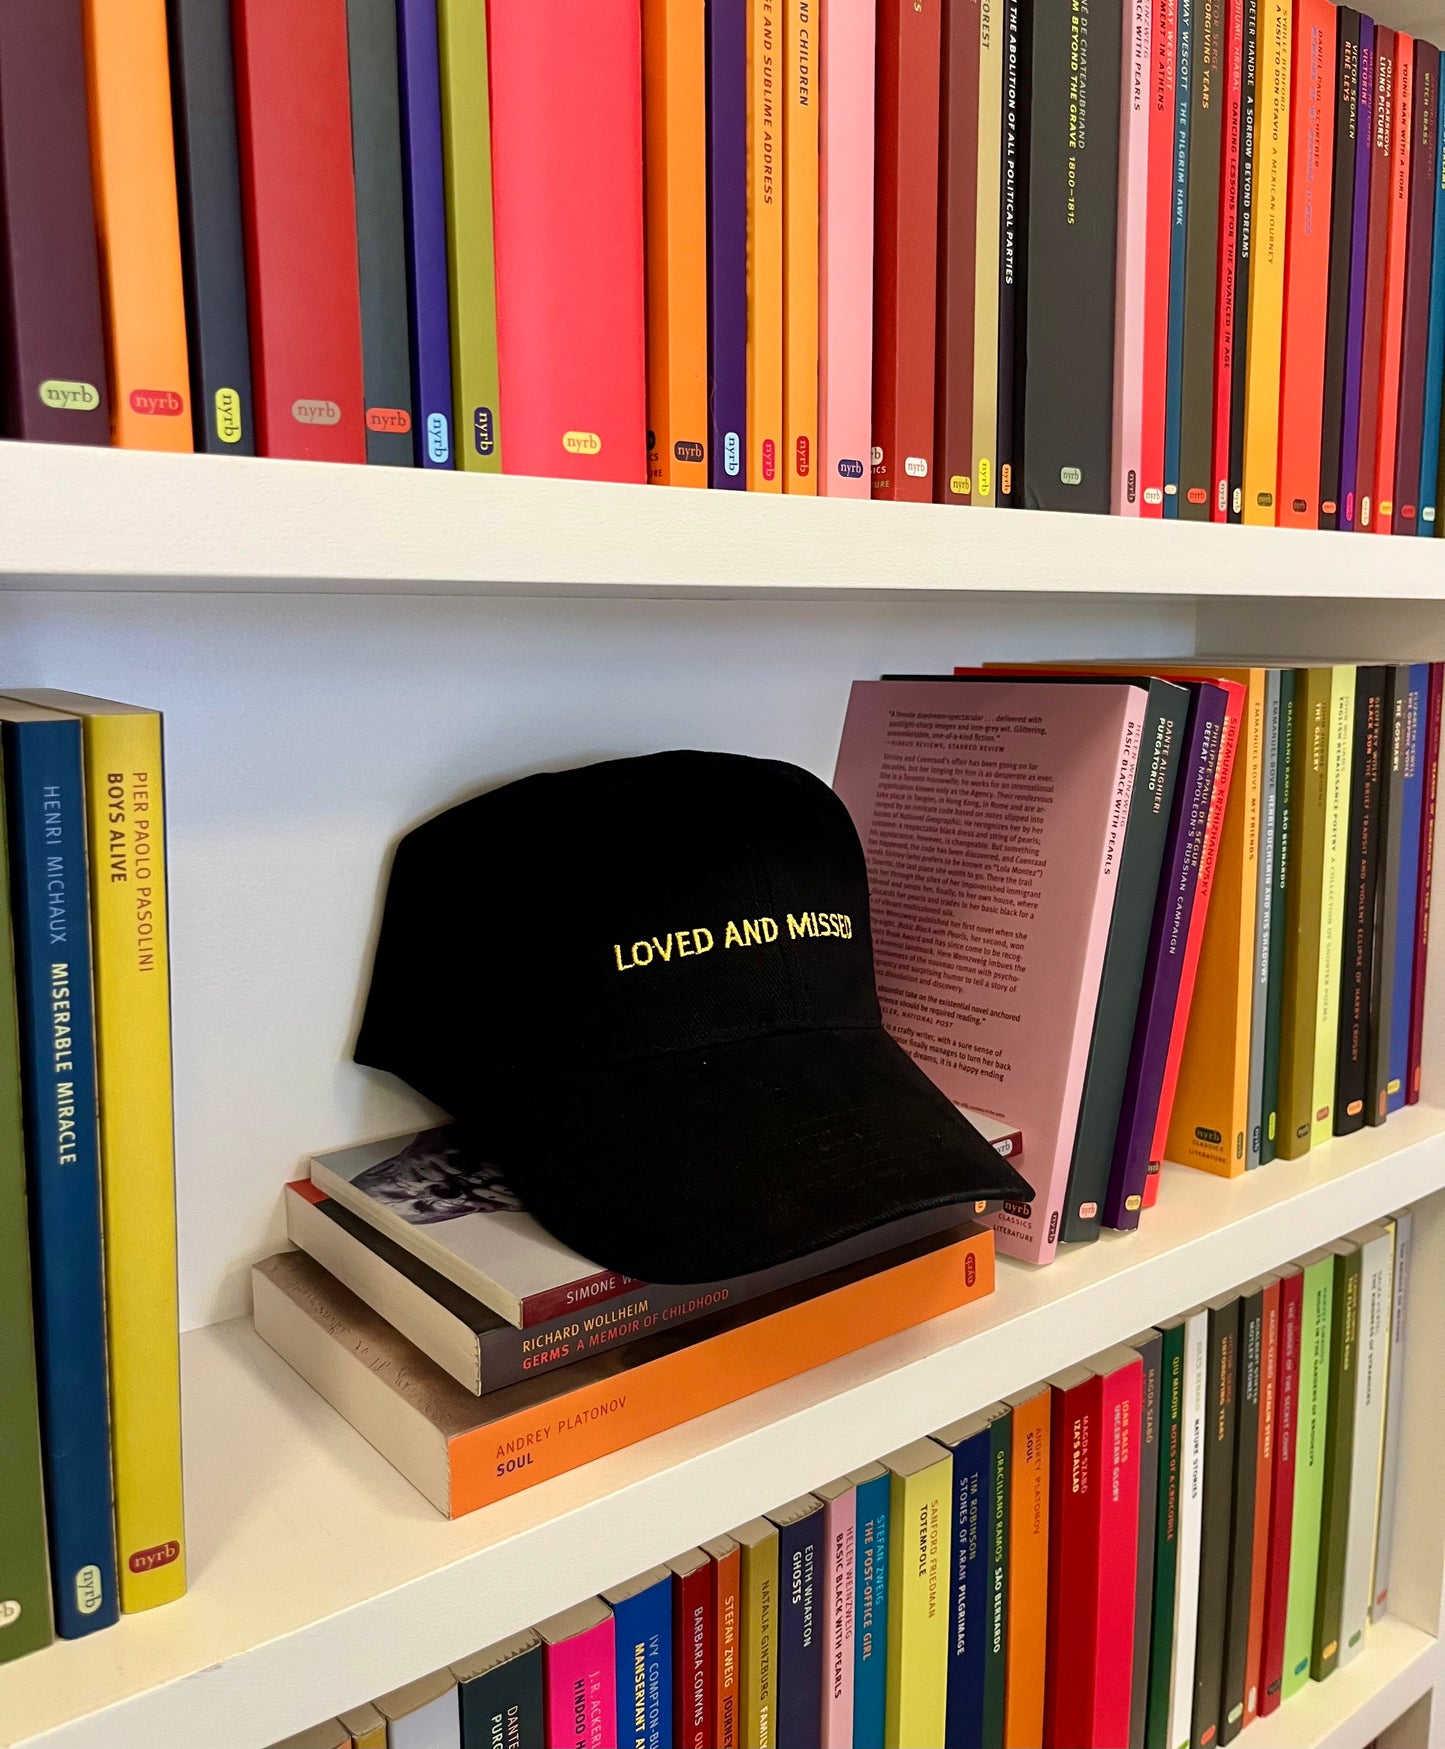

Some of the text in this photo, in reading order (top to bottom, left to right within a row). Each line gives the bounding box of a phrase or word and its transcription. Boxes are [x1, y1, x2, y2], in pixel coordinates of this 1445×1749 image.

[799, 28, 809, 107] CHILDREN
[1070, 15, 1079, 73] BEYOND
[1344, 40, 1352, 70] RENÉ
[1070, 75, 1078, 100] THE
[1078, 17, 1088, 149] DE CHATEAUBRIAND
[1157, 42, 1166, 112] IN ATHENS
[1202, 69, 1210, 110] YEARS
[1376, 56, 1386, 149] LIVING PICTURES
[763, 16, 773, 206] AND SUBLIME ADDRESS
[1069, 103, 1077, 149] GRAVE
[1176, 31, 1190, 226] WESCOTT THE PILGRIM HAWK
[1242, 0, 1256, 259] PETER HANDKE A SORROW BEYOND DREAMS
[1005, 7, 1017, 285] THE ABOLITION OF ALL POLITICAL PARTIES
[47, 385, 94, 407] nyrb
[135, 394, 179, 414] nyrb
[217, 394, 239, 437] nyrb
[298, 402, 335, 421] nyrb
[371, 412, 406, 430] nyrb
[428, 418, 448, 457] nyrb
[475, 411, 493, 451] nyrb
[567, 436, 598, 452] nyrb
[677, 444, 702, 460] nyrb
[725, 437, 739, 471] nyrb
[797, 440, 809, 473] nyrb
[763, 443, 773, 477] nyrb
[840, 460, 861, 477] nyrb
[907, 461, 925, 475] nyrb
[1148, 717, 1166, 792] PURGATORIO
[1152, 720, 1174, 814] DANTE ALIGHIERI
[1199, 721, 1213, 763] DEFEAT
[1200, 724, 1220, 807] PHILIPPE-PAUL
[1392, 721, 1401, 772] GOSHAWK
[1104, 721, 1135, 876] BASIC BLACK WITH PEARLS
[1197, 811, 1206, 826] DE
[1200, 716, 1237, 897] SIGIZMUND KRZHIZHANOVSKY
[108, 772, 127, 883] BOYS ALIVE
[131, 771, 154, 973] PIER PAOLO PASOLINI
[1179, 842, 1193, 892] RUSSIAN
[1280, 833, 1288, 889] BERNARDO
[613, 911, 852, 971] LOVED AND MISSED
[1169, 895, 1185, 955] CAMPAIGN
[43, 785, 77, 1166] HENRI MICHAUX MISERABLE MIRACLE
[932, 979, 964, 994] discovery.
[990, 981, 1007, 993] story
[897, 1025, 915, 1037] crafty
[938, 998, 1021, 1022] existential novel anchored
[929, 1043, 1012, 1072] manages back
[958, 1062, 1004, 1082] happy ending
[993, 1224, 1033, 1243] LITERATURE
[998, 1213, 1032, 1229] CLASSICS
[1004, 1201, 1030, 1218] nyrb
[566, 1276, 616, 1304] SIMONE
[522, 1299, 650, 1353] RICHARD WOLLHEIM
[522, 1288, 730, 1370] GERMS A MEMOIR OF CHILDHOOD
[1170, 1356, 1180, 1420] QIU MIAOJIN
[495, 1395, 628, 1459] ANDREY PLATONOV
[1121, 1400, 1130, 1463] JOAN SALES
[496, 1452, 534, 1477] SOUL
[1072, 1450, 1080, 1493] BALLAD
[919, 1504, 928, 1578] TOTEMPOLE
[968, 1472, 978, 1560] TIM ROBINSON
[995, 1520, 1003, 1563] RAMOS
[134, 1544, 176, 1569] nyrb
[792, 1551, 802, 1605] GHOSTS
[844, 1526, 854, 1640] HELEN WEINZWEIG
[875, 1515, 885, 1605] STEFAN ZWEIG
[928, 1499, 939, 1619] SANFORD FRIEDMAN
[957, 1477, 968, 1656] STONES OF ARAN PILGRIMAGE
[77, 1569, 101, 1608] nyrb
[802, 1545, 814, 1648] EDITH WHARTON
[833, 1533, 843, 1699] BASIC BLACK WITH PEARLS
[862, 1520, 873, 1661] THE POST-OFFICE GIRL
[724, 1595, 734, 1688] STEFAN ZWEIG
[760, 1580, 770, 1701] NATALIA GINZBURG
[993, 1592, 1002, 1654] BERNARDO
[634, 1642, 645, 1732] MANSERVANT
[694, 1606, 703, 1726] BARBARA COMYNS
[574, 1678, 586, 1735] HINDOO
